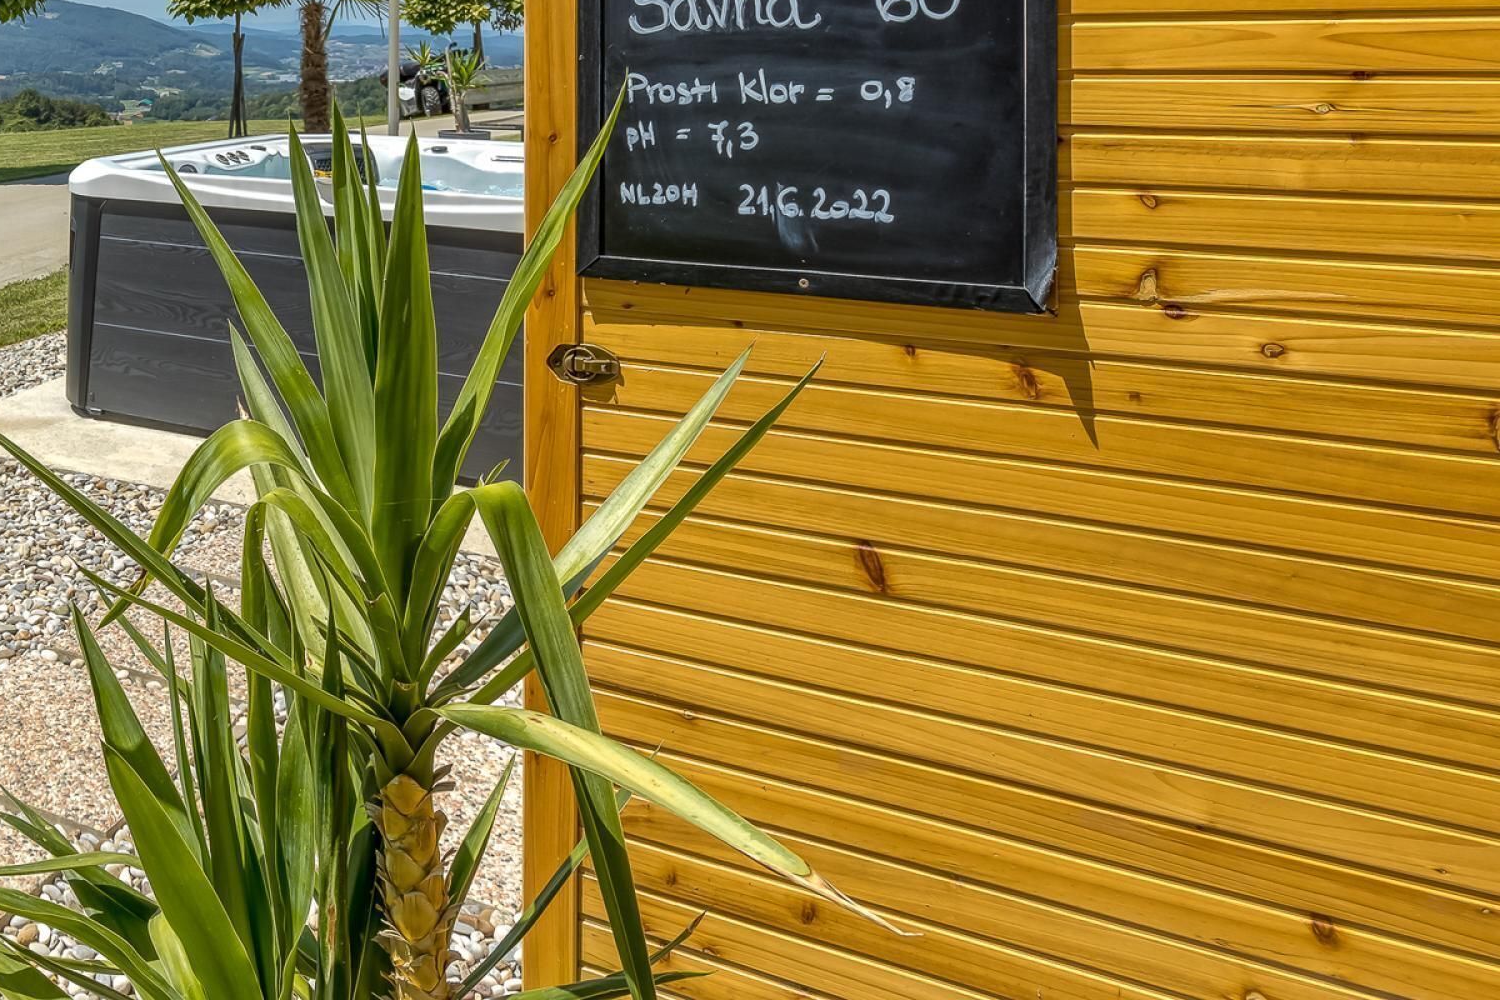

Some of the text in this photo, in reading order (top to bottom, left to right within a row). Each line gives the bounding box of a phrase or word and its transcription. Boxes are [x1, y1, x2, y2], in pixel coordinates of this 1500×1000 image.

[626, 72, 717, 105] Prosti
[626, 120, 656, 152] pH
[707, 120, 760, 159] 7,3
